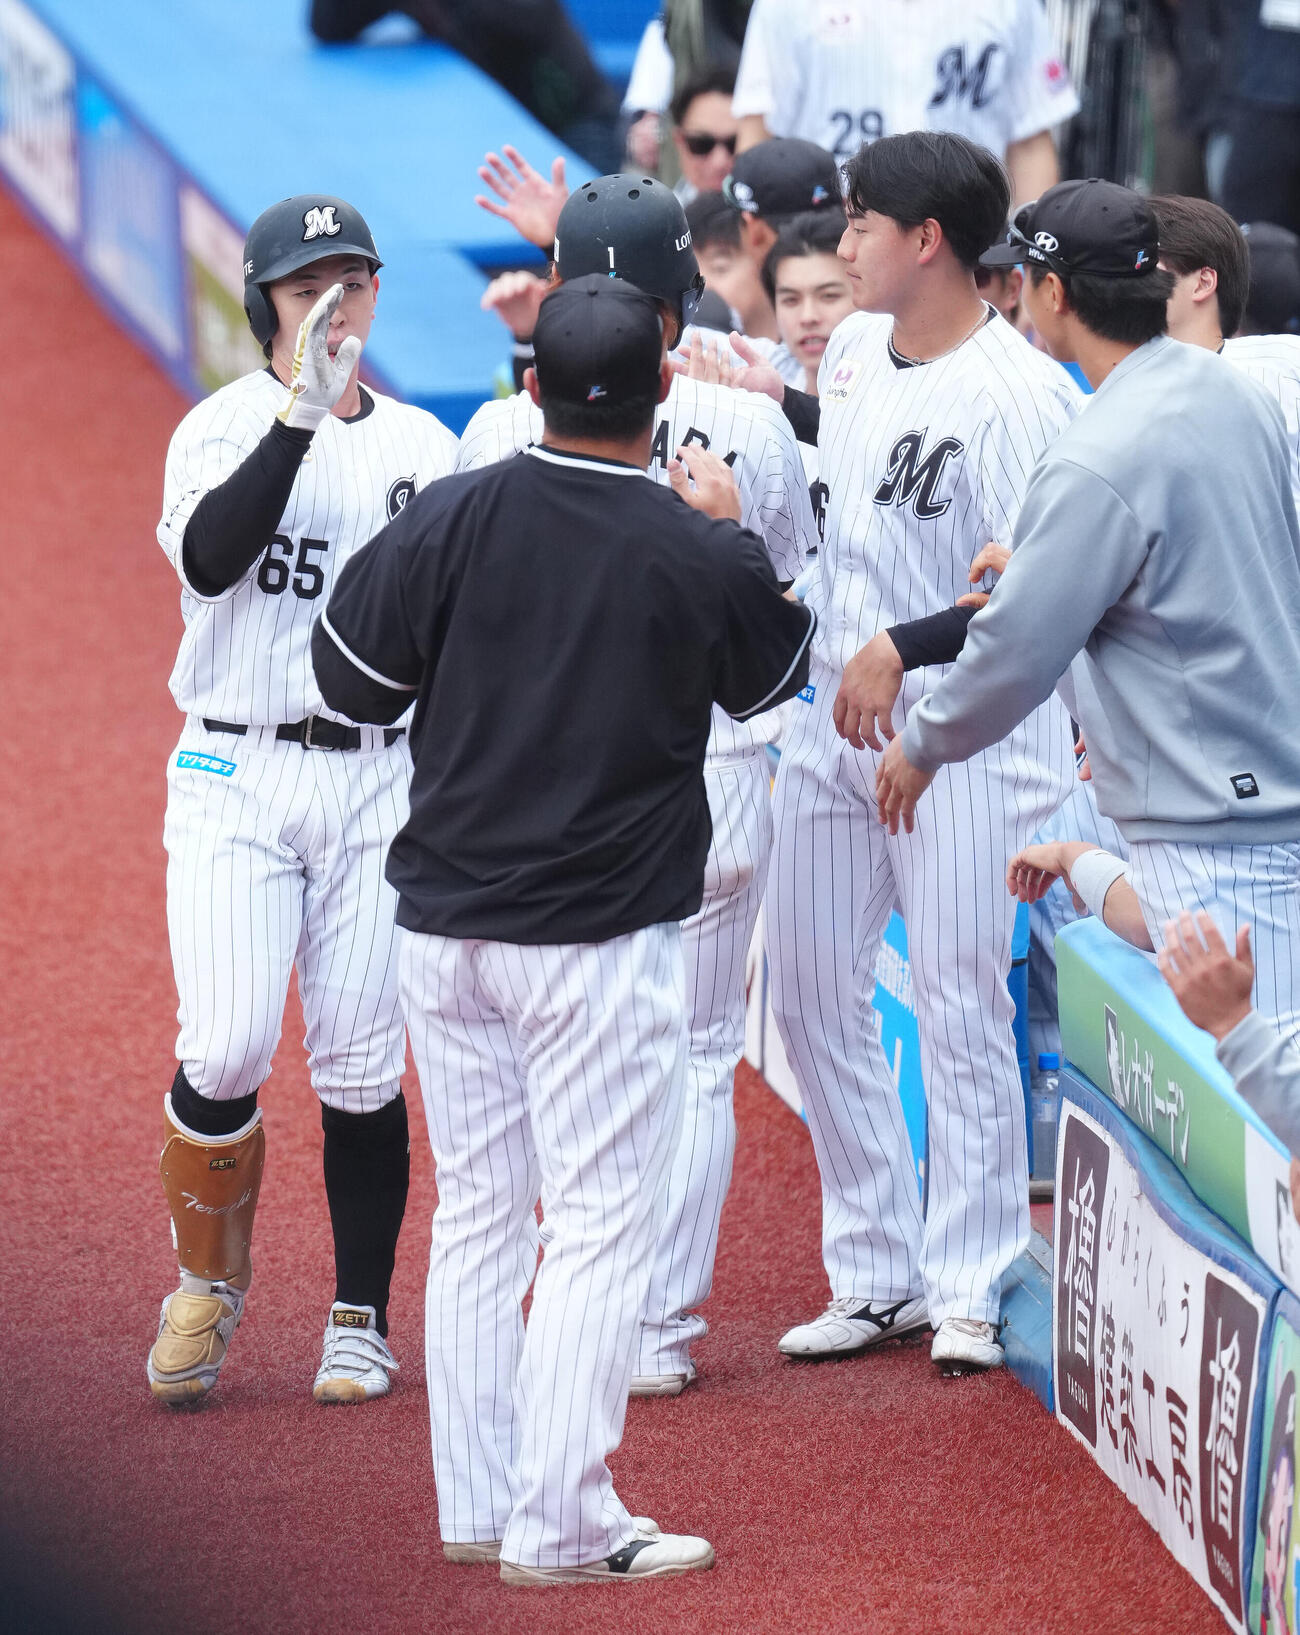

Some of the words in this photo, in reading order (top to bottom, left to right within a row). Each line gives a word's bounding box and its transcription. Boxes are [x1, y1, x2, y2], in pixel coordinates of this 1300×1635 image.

[302, 206, 341, 240] M
[607, 246, 615, 269] 1
[872, 426, 965, 521] M
[257, 533, 329, 600] 65
[335, 1312, 368, 1324] ZETT
[1100, 1300, 1195, 1540] 建築工房
